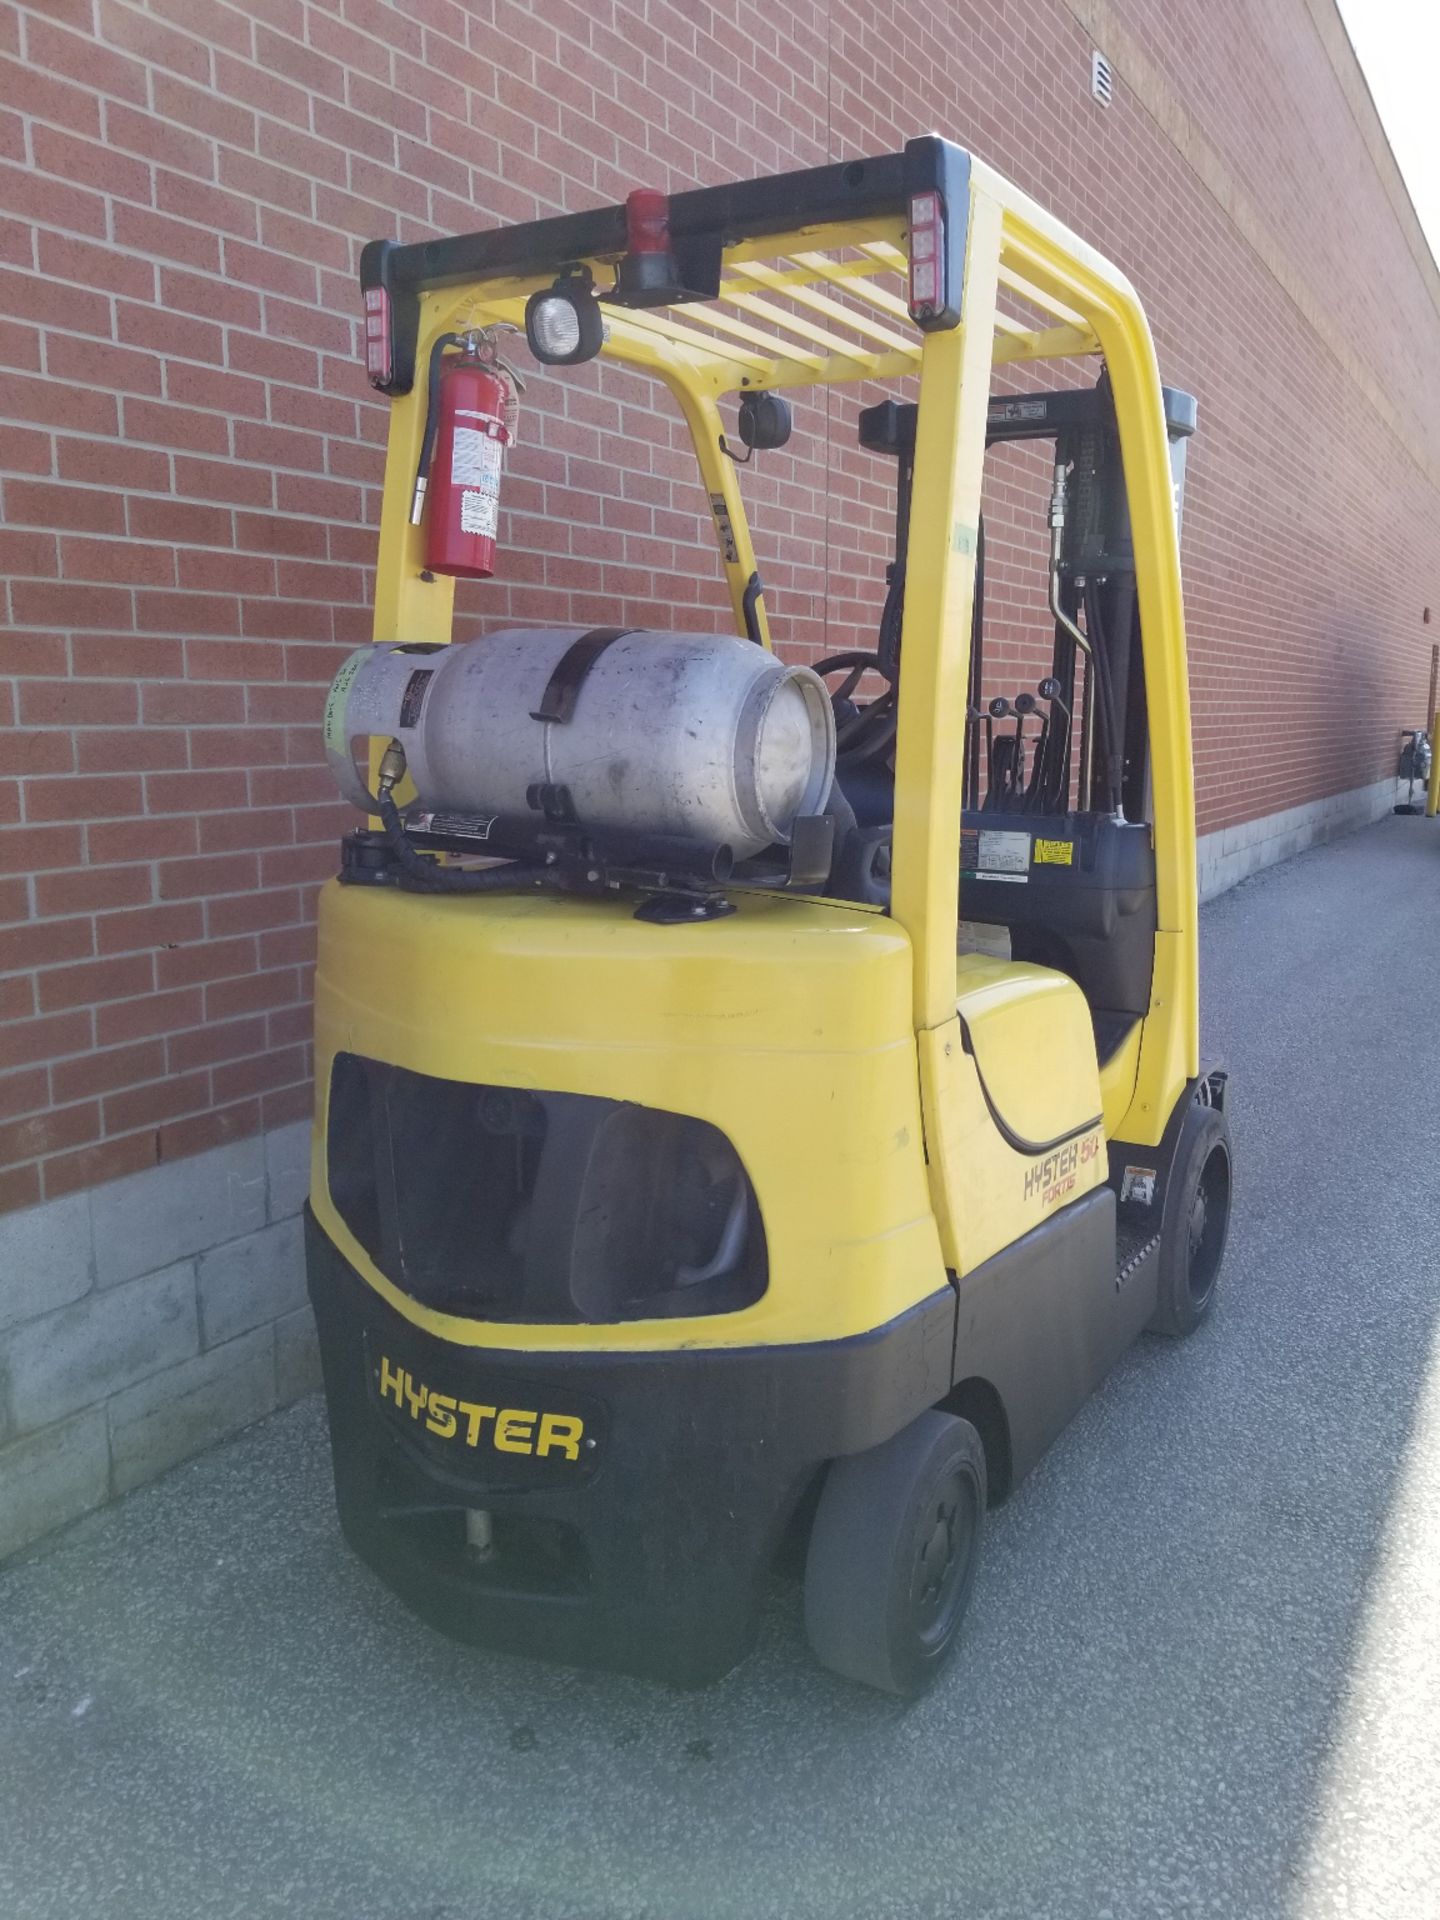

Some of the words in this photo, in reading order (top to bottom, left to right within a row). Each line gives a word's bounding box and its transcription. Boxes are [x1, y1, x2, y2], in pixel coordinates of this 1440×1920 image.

[1023, 1142, 1078, 1202] HYSTER
[1041, 1172, 1076, 1208] FORTIS
[380, 1356, 584, 1461] HYSTER
